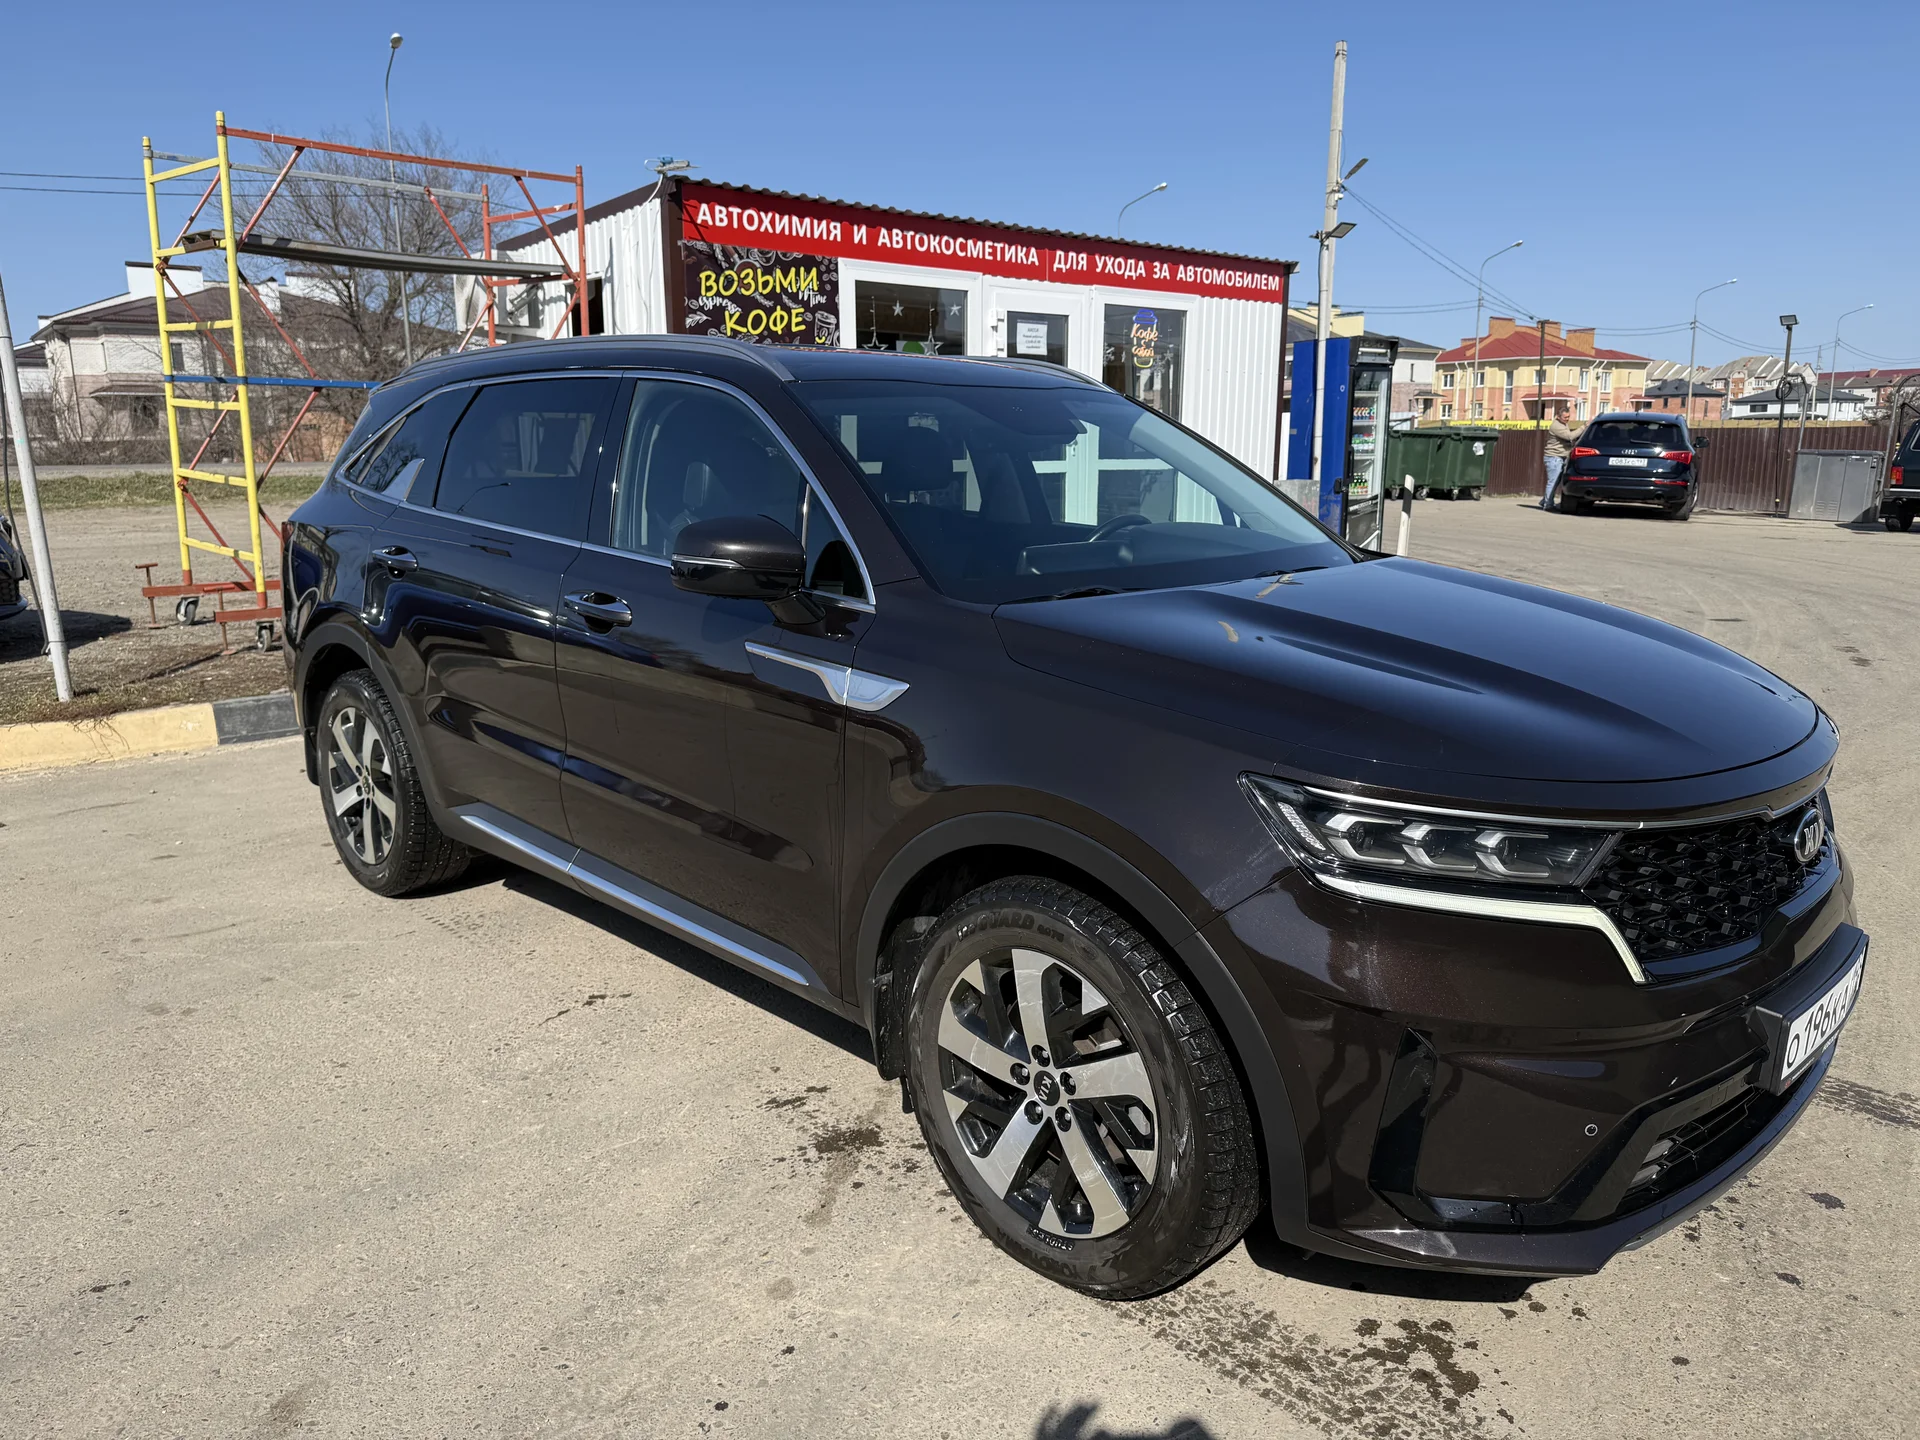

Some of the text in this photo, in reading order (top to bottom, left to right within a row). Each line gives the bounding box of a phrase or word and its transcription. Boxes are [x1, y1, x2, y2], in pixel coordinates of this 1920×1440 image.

[697, 203, 1280, 291] АВТОХИМИЯ И АВТОКОСМЕТИКА ДЛЯ УХОДА ЗА АВТОМОБИЛЕМ
[699, 266, 819, 297] ВОЗЬМИ
[724, 305, 806, 337] КОФЕ
[1131, 324, 1159, 343] Кофе
[1038, 1075, 1052, 1101] KIA
